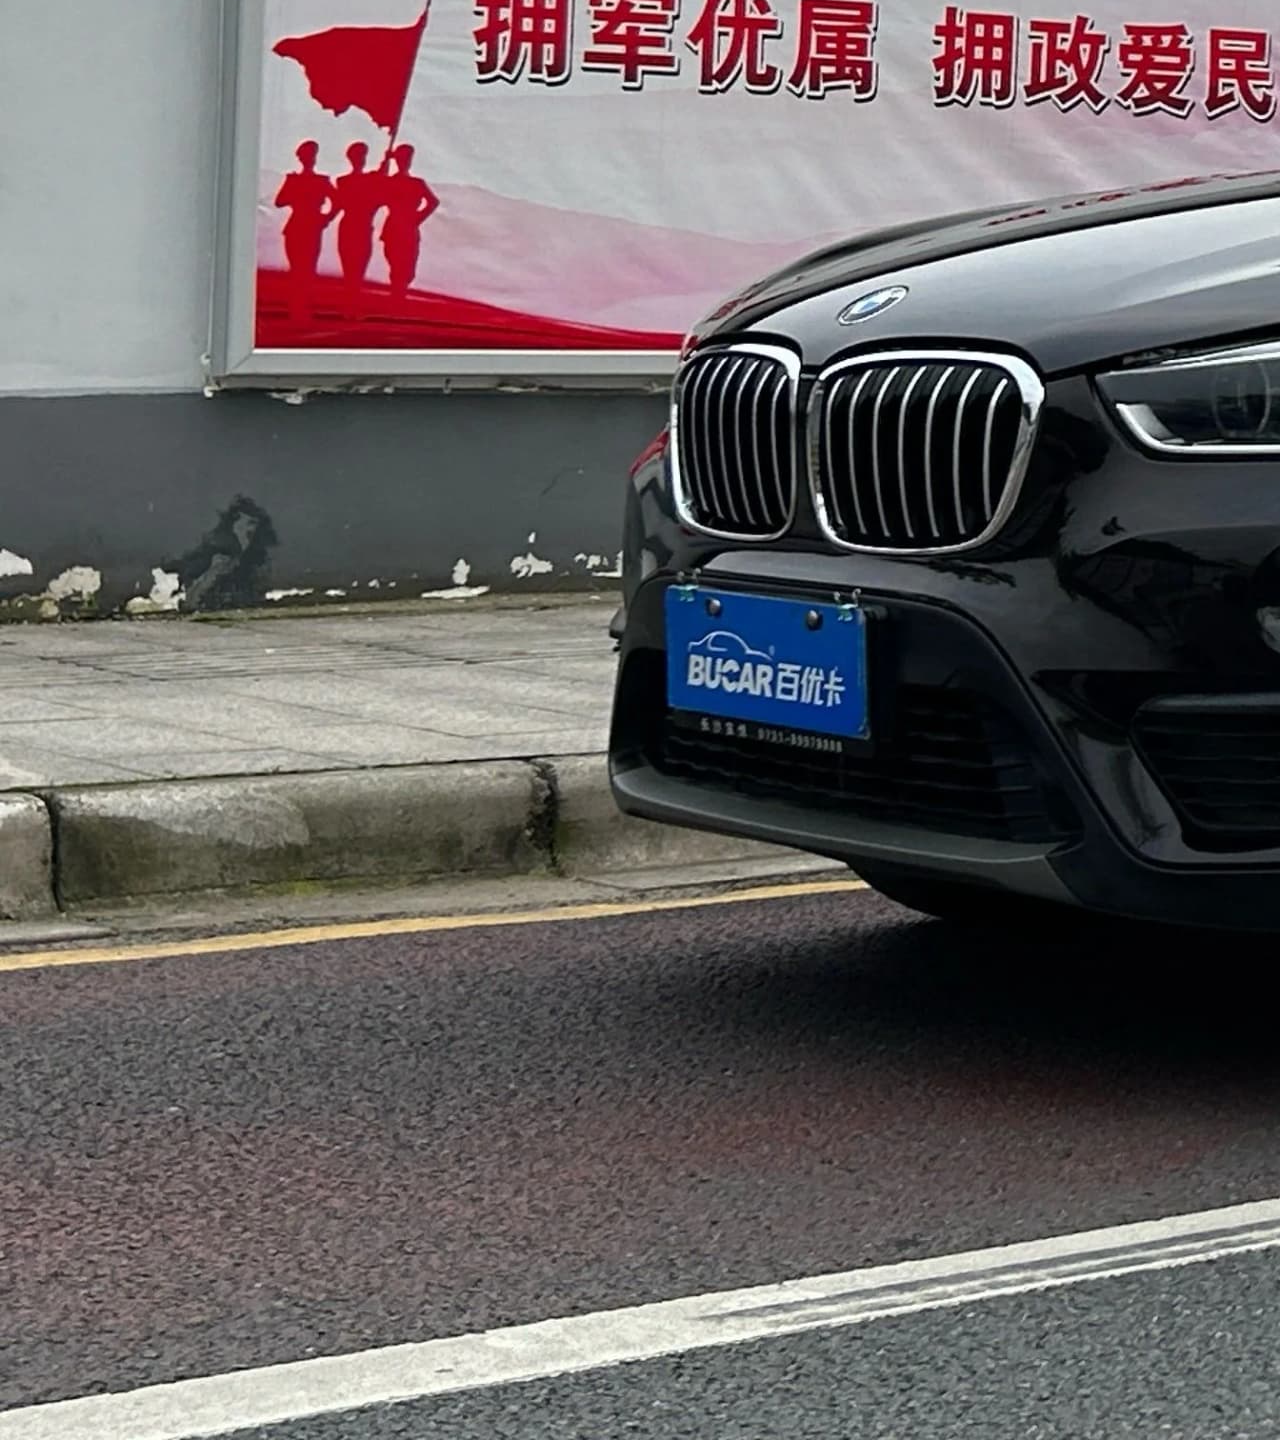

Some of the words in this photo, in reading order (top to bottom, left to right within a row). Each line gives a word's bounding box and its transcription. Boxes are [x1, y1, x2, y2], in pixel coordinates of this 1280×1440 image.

[932, 6, 1278, 122] 拥政爱民
[686, 654, 774, 698] BUCAR
[775, 662, 846, 707] 百优卡
